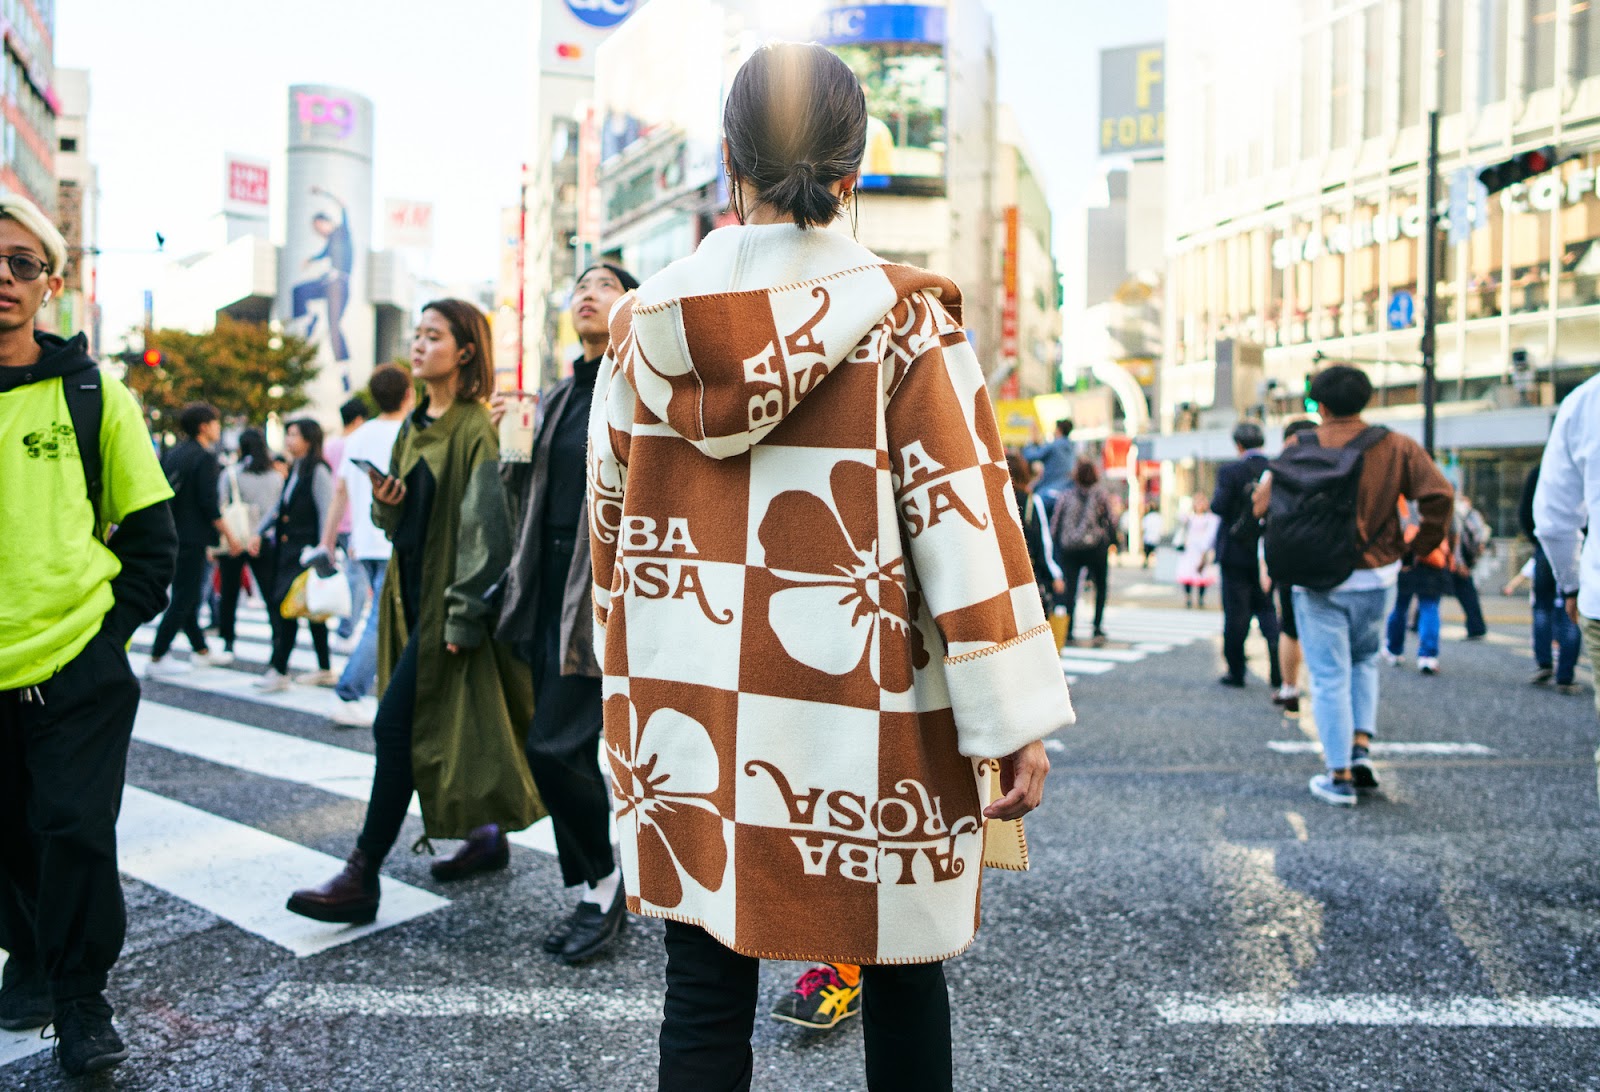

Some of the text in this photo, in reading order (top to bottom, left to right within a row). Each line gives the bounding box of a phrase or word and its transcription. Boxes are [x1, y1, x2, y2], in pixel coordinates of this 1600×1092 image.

[295, 91, 355, 140] 109
[1499, 164, 1600, 214] COF
[743, 759, 950, 838] ROSA
[789, 815, 978, 885] ALBA
